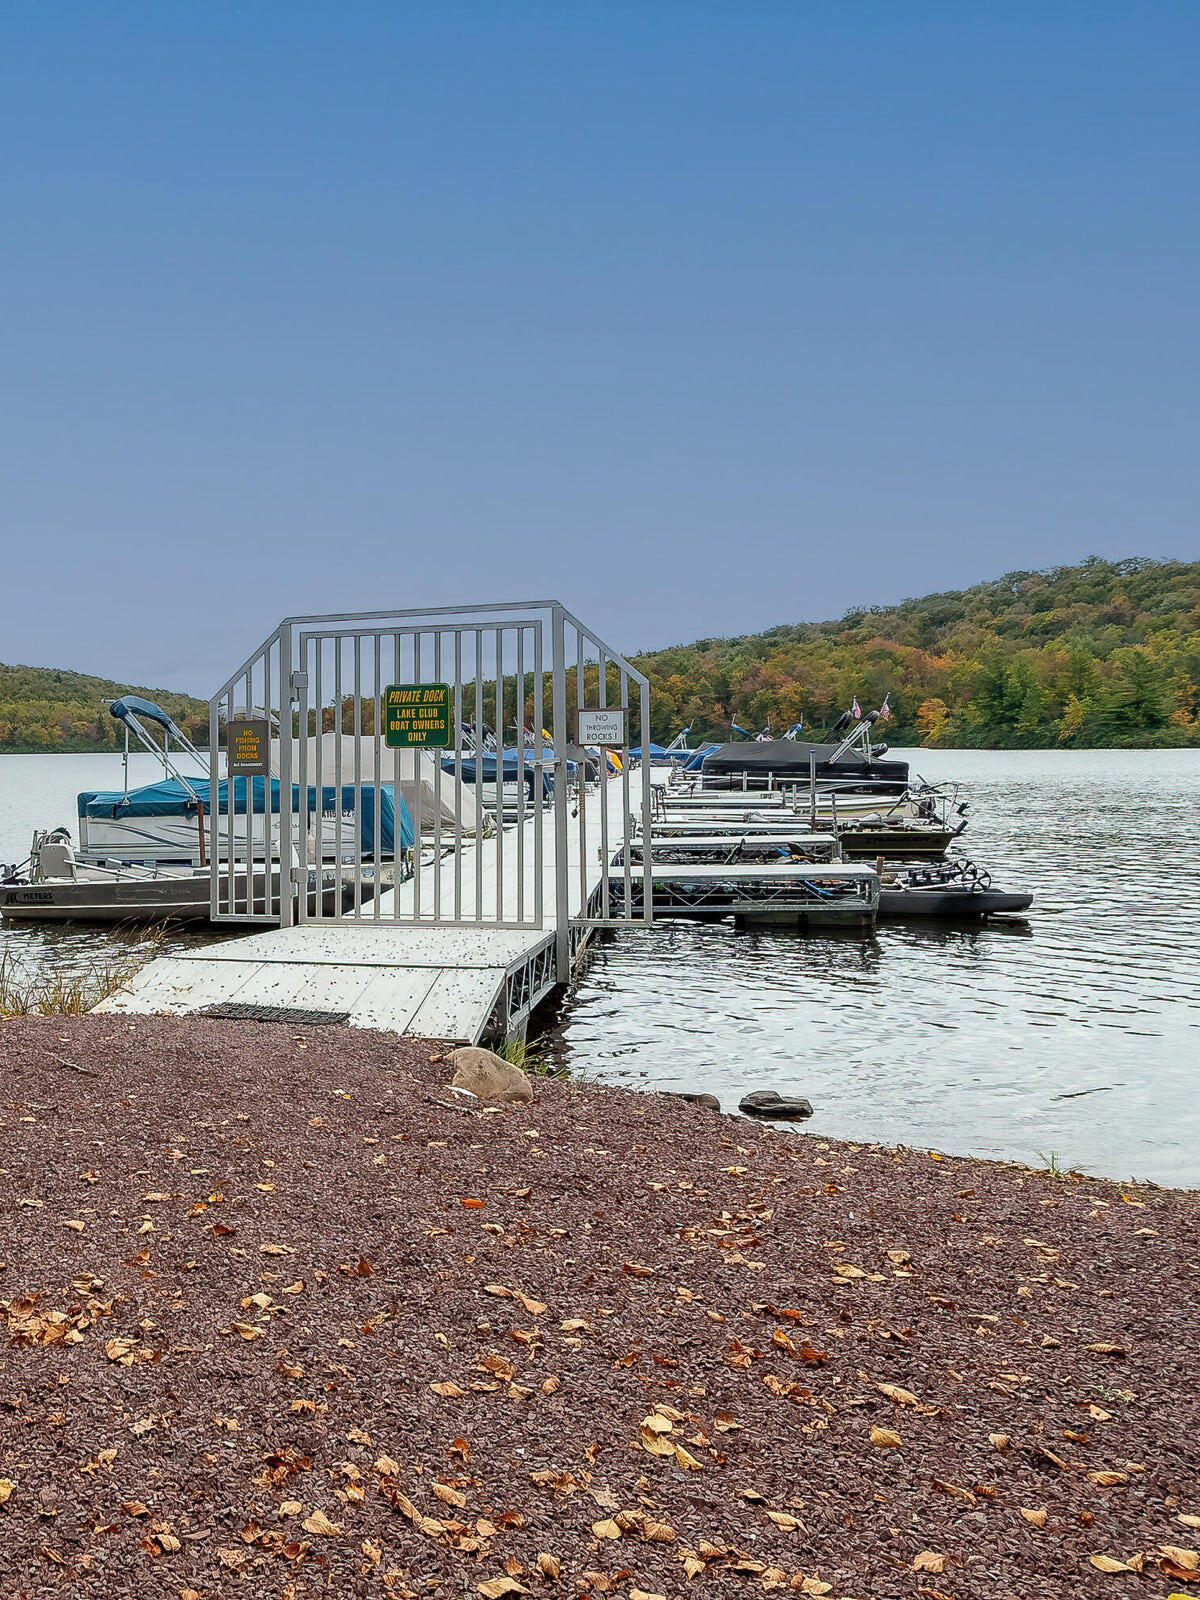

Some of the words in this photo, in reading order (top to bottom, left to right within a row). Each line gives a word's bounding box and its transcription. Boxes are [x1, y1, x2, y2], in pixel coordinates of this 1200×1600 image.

[389, 690, 421, 703] PRIVATE
[423, 689, 445, 702] DOCK
[397, 709, 416, 718] LAKE
[419, 708, 438, 718] CLUB
[390, 720, 409, 730] BOAT
[412, 720, 444, 730] OWNERS
[408, 732, 427, 742] ONLY
